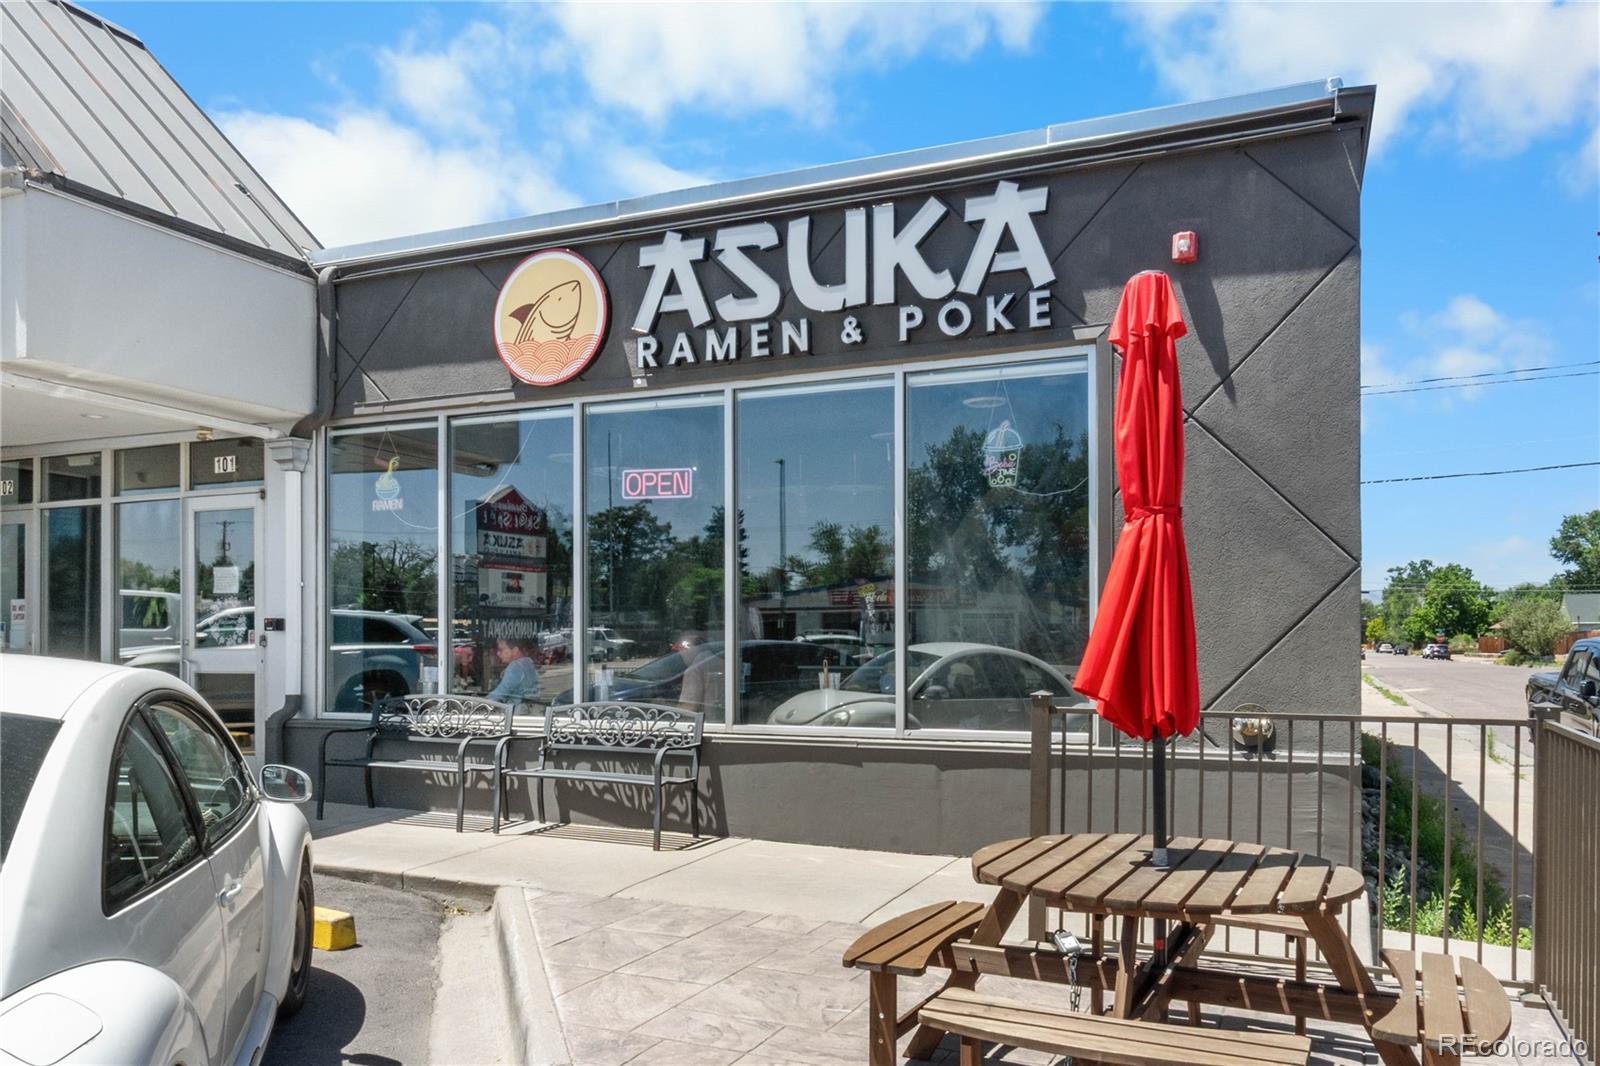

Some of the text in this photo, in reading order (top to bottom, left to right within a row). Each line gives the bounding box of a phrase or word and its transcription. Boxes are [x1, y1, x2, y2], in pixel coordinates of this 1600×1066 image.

[632, 180, 1056, 333] ASUKA
[637, 289, 1051, 368] RAMEN & POKE
[216, 456, 235, 472] 101
[626, 472, 689, 496] OPEN
